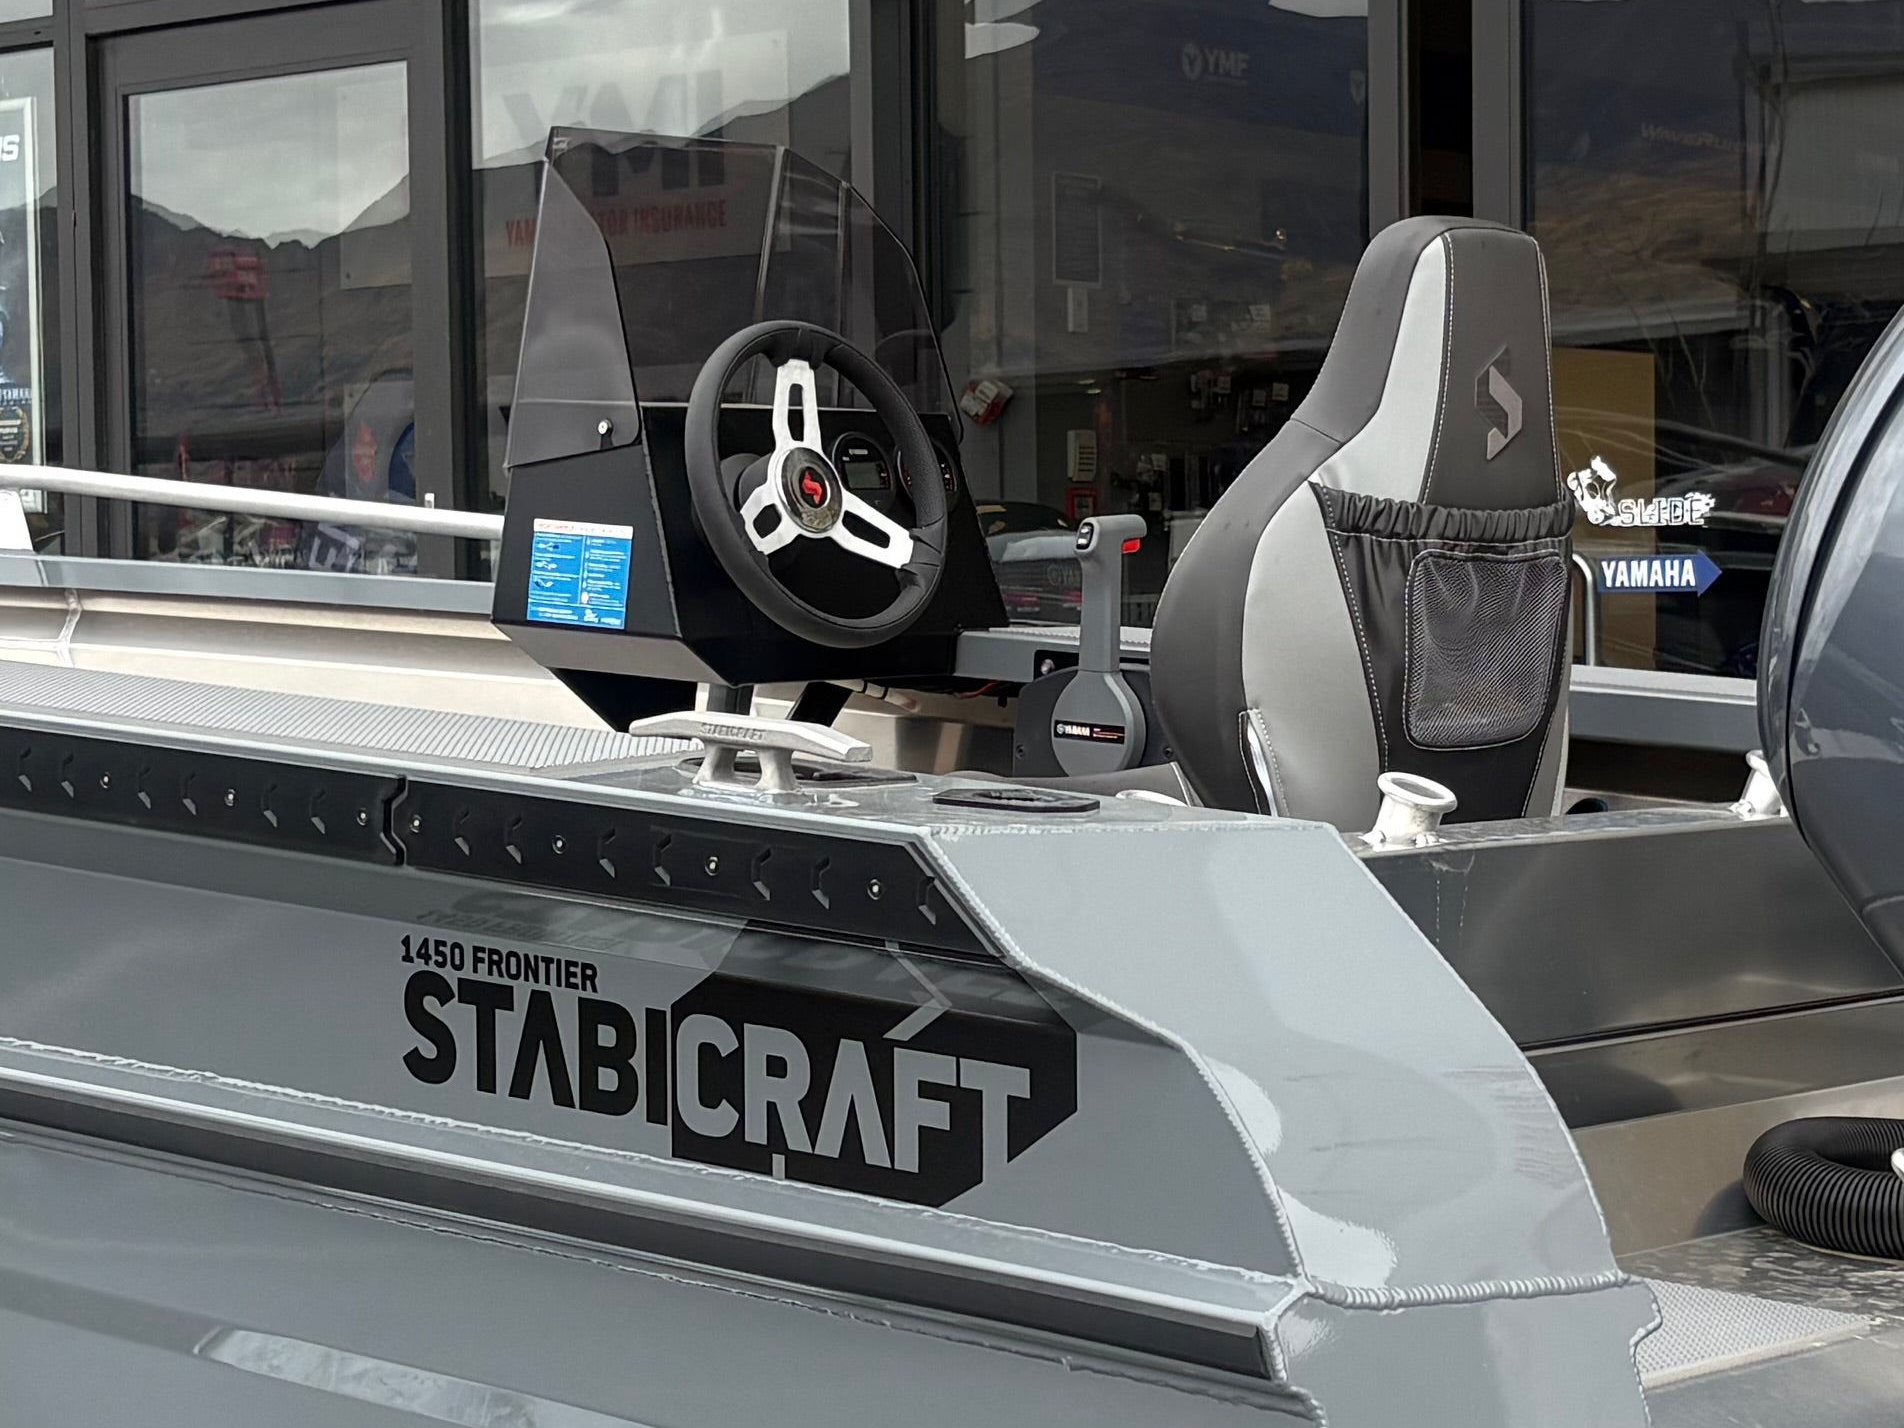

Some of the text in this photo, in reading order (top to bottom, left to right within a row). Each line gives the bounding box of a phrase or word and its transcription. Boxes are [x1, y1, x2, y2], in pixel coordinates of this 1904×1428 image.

[1618, 497, 1705, 526] SLIDE
[1601, 559, 1696, 587] YAMAHA
[401, 935, 599, 993] 1450 FRONTIER
[402, 969, 1030, 1174] STABICRAFT
